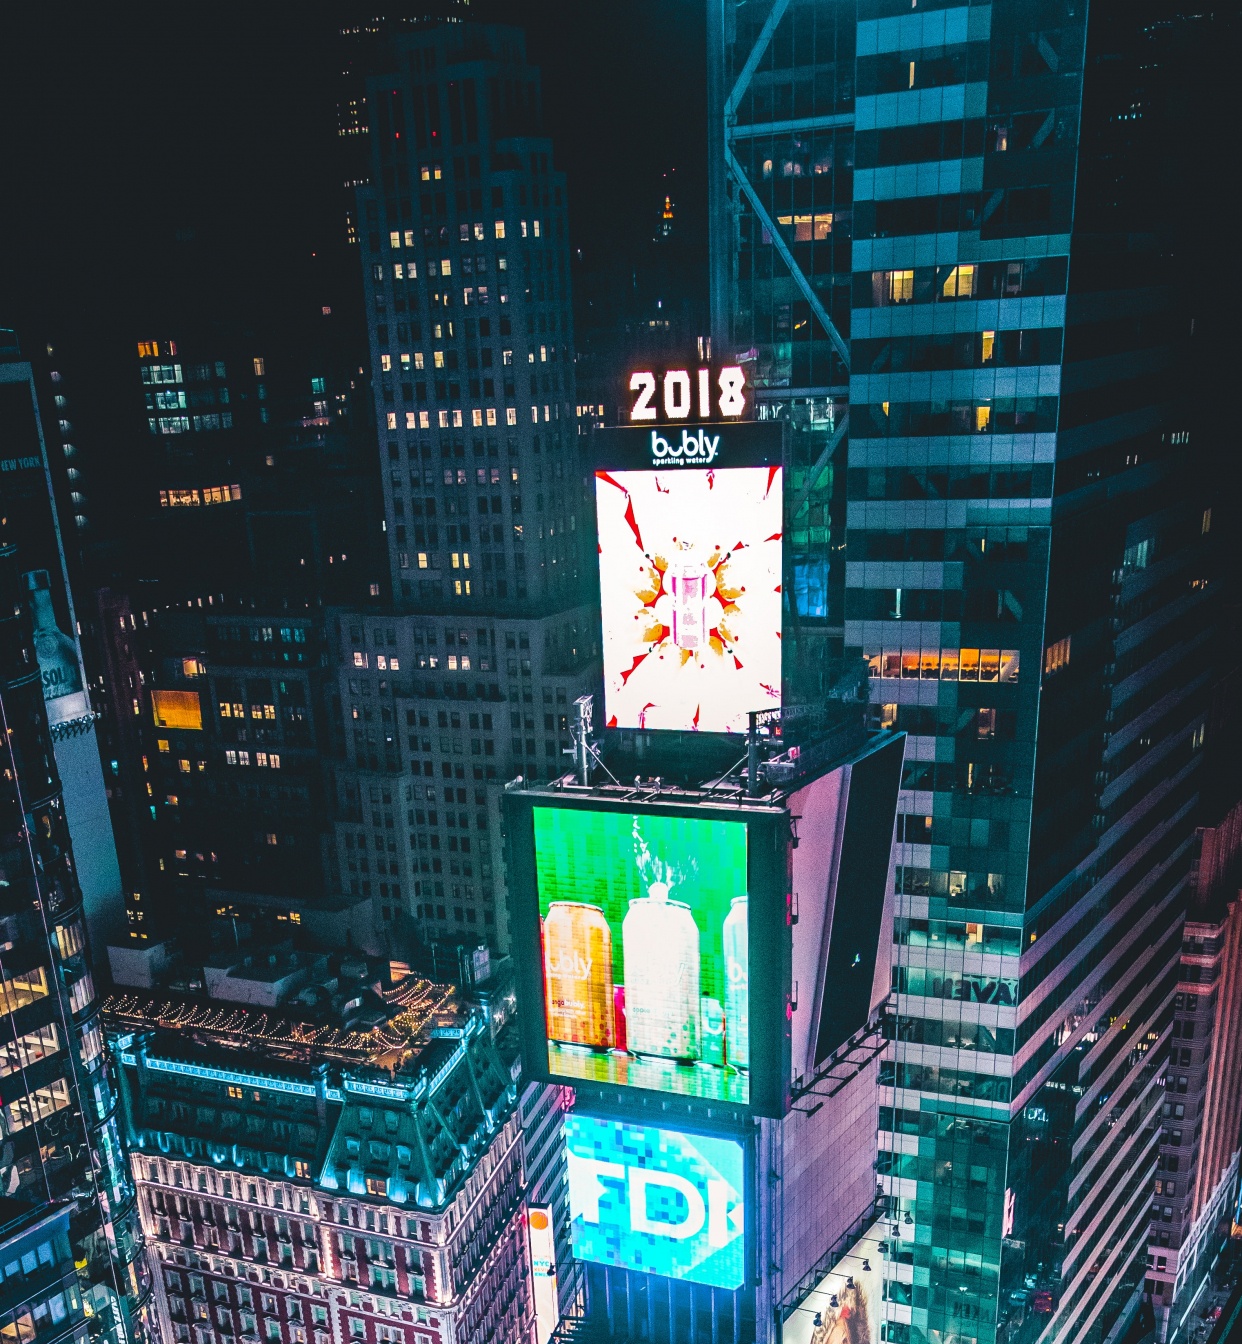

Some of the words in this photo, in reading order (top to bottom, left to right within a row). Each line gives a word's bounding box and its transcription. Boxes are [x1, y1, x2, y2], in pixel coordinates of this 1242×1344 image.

[629, 366, 746, 421] 2018
[17, 455, 41, 470] YORK
[652, 457, 684, 466] sparkling
